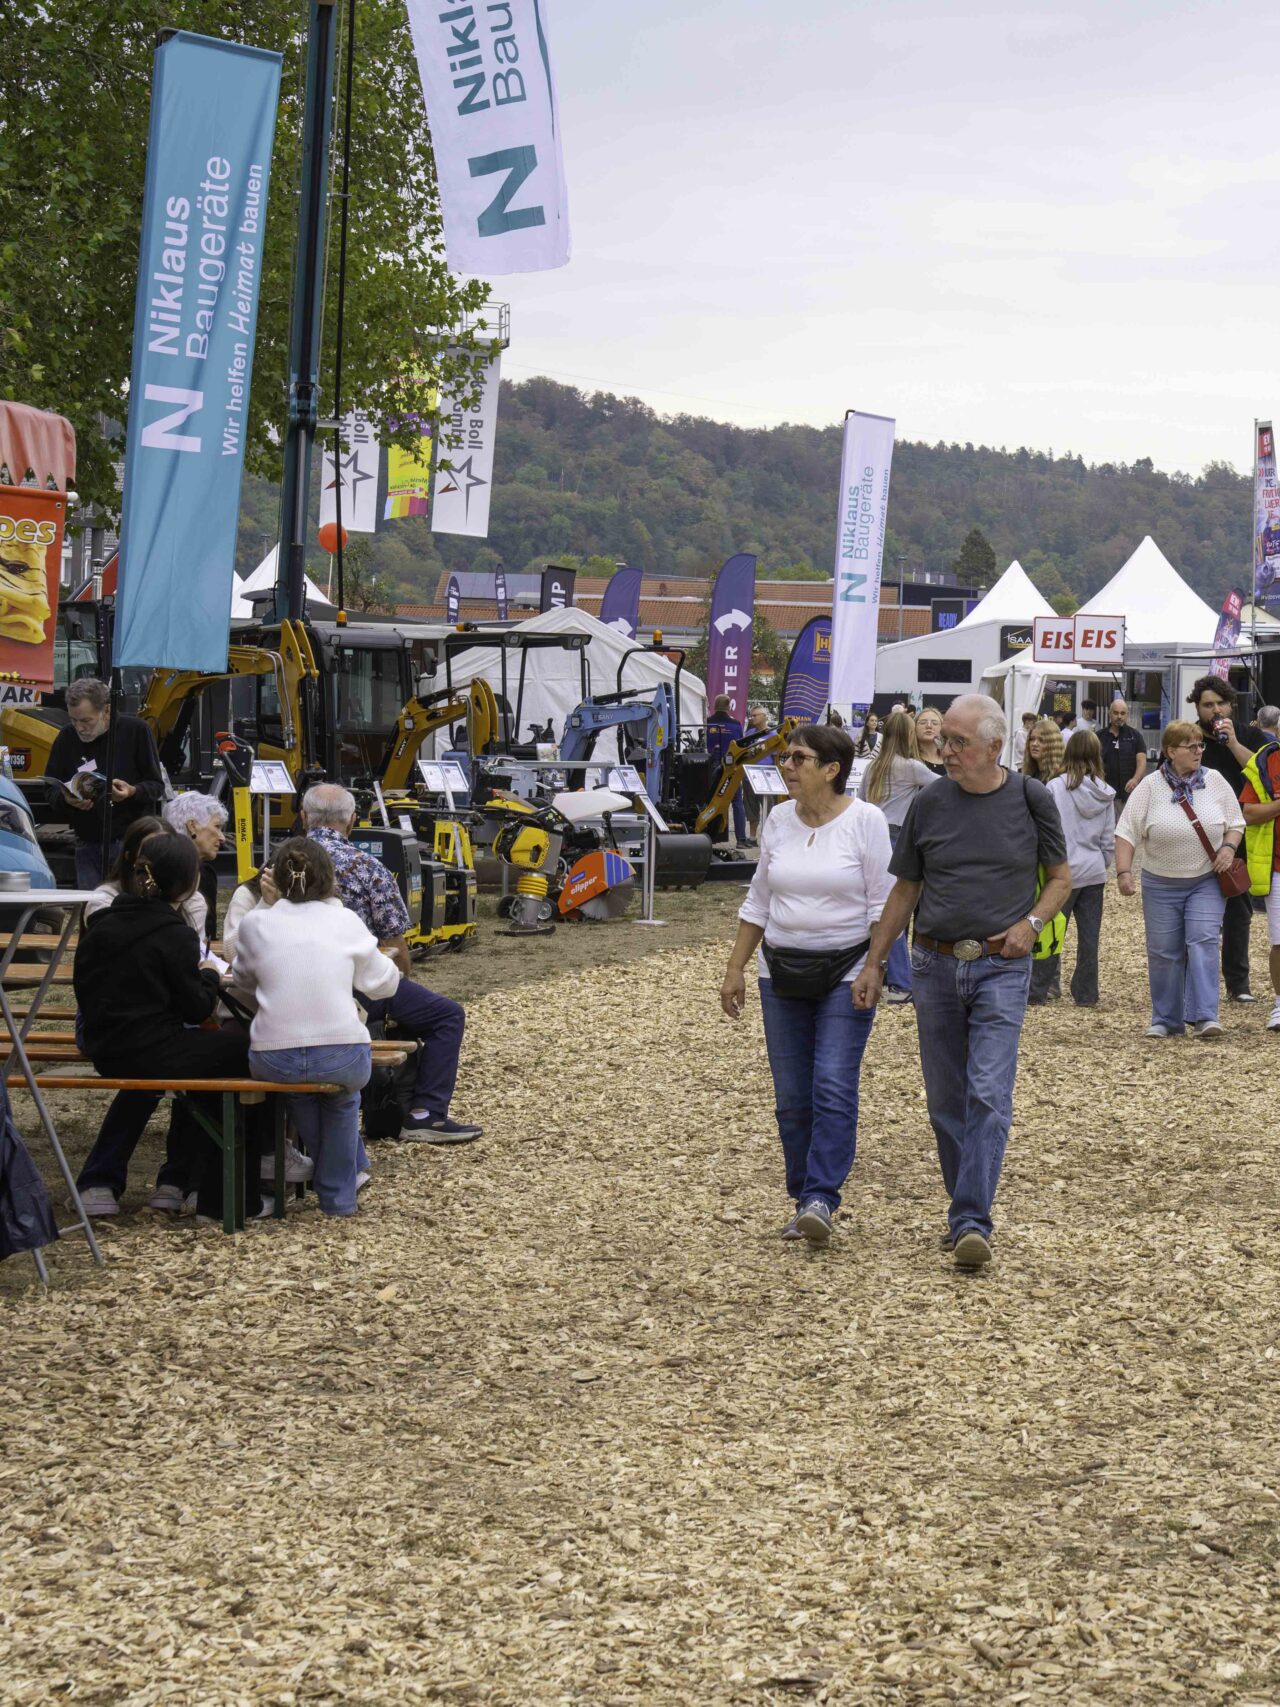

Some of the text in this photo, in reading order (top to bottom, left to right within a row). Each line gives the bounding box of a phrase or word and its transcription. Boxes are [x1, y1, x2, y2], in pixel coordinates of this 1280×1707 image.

[438, 0, 491, 116] Nikl
[467, 144, 546, 238] N
[148, 195, 191, 356] Niklaus
[185, 156, 231, 360] Baugeräte
[221, 163, 263, 457] Wir helfen Heimat bauen
[140, 383, 204, 453] N
[353, 412, 369, 444] Boll
[467, 418, 484, 450] Boll
[841, 485, 860, 559] Niklaus
[854, 465, 875, 561] Baugeräte
[839, 572, 868, 603] N
[1040, 630, 1073, 650] EIS
[1080, 629, 1117, 649] EIS
[0, 686, 34, 703] AR
[724, 646, 739, 719] STER
[570, 876, 598, 895] clipper
